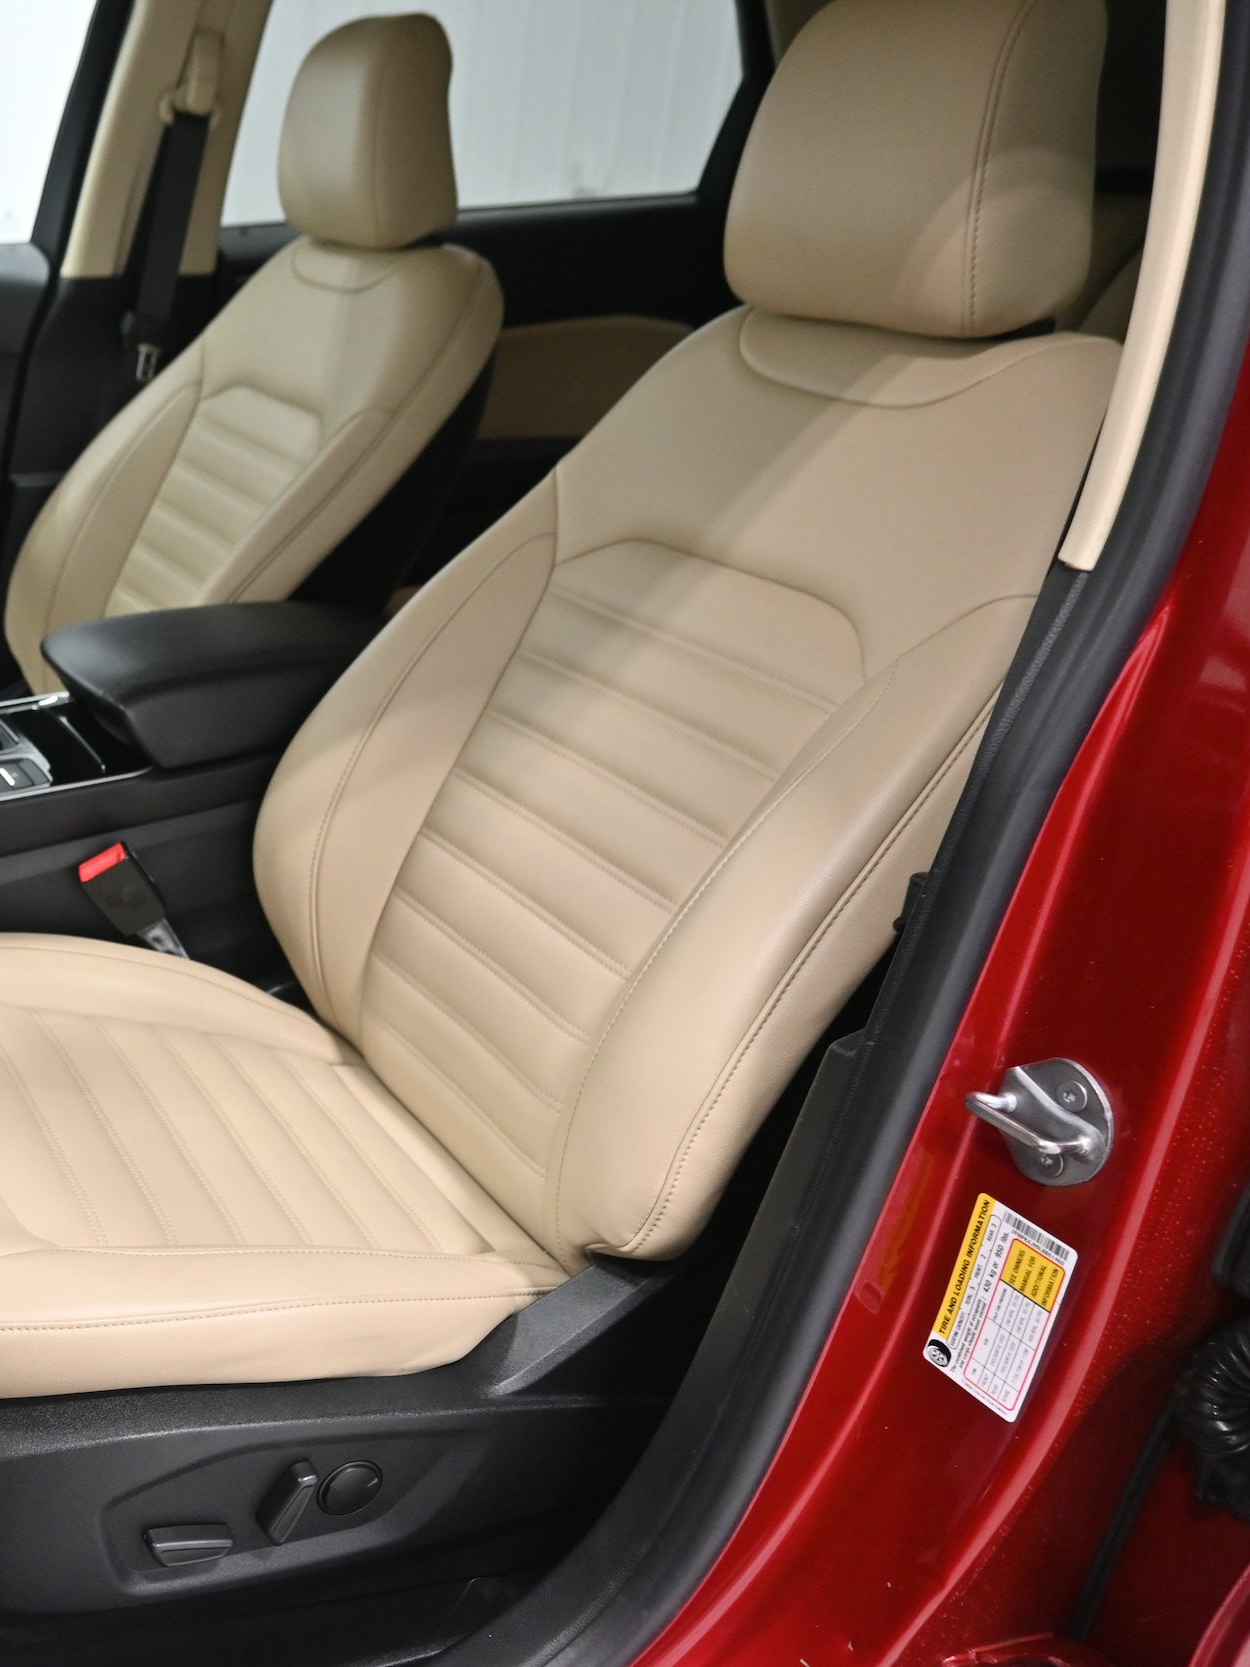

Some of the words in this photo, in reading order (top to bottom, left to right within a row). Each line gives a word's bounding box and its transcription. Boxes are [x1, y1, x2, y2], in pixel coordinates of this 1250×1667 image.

[999, 1230, 1009, 1243] lbs.
[994, 1243, 1004, 1258] 950
[938, 1314, 950, 1335] TIRE
[946, 1295, 957, 1315] AND
[952, 1258, 970, 1296] LOADING
[965, 1198, 990, 1258] INFORMATION
[988, 1268, 997, 1278] kg
[992, 1260, 998, 1269] or
[1008, 1272, 1016, 1285] SEE
[1012, 1248, 1025, 1274] OWNERS
[1018, 1268, 1031, 1292] MANUAL
[1027, 1254, 1035, 1268] FOR
[982, 1278, 991, 1293] 430
[1030, 1263, 1046, 1298] ADDITIONAL
[1040, 1267, 1059, 1307] INFORMATION
